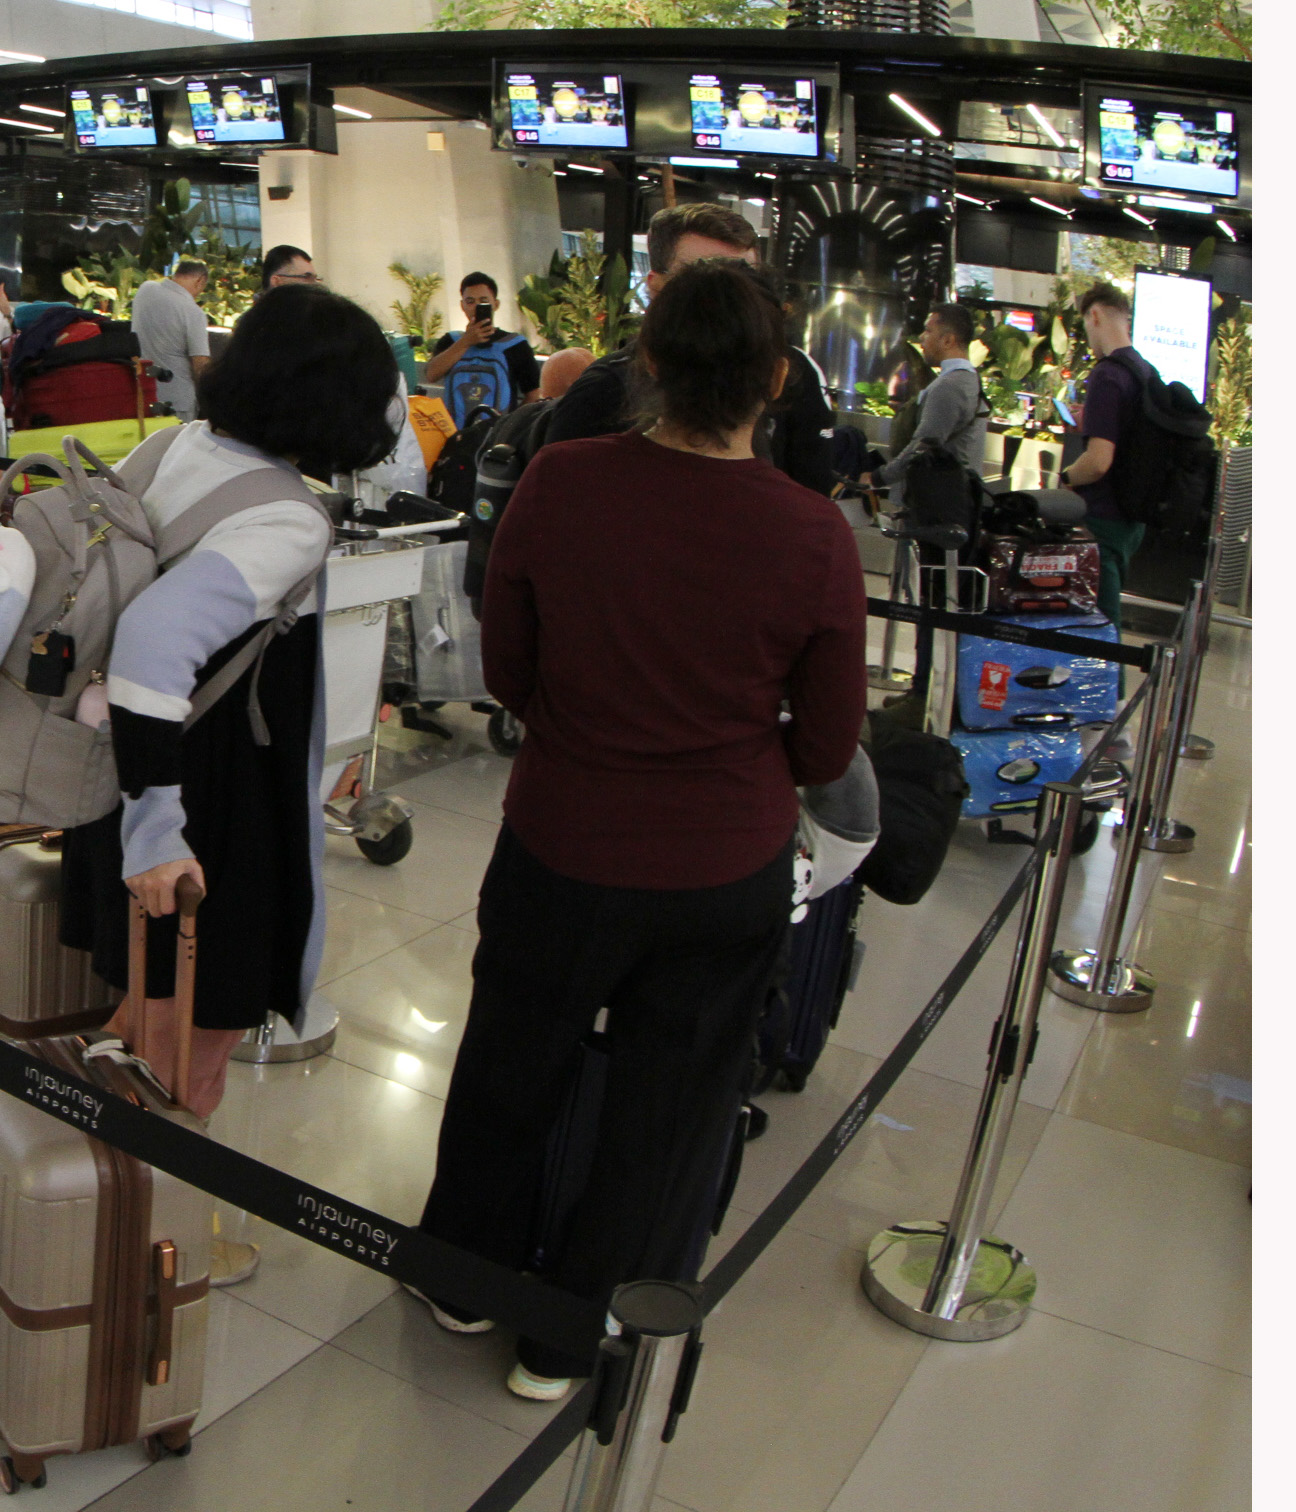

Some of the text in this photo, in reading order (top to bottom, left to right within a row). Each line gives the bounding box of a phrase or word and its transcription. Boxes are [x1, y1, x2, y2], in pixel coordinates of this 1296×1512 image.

[514, 88, 530, 97] C17
[1143, 335, 1198, 350] AVAILABLE
[1154, 324, 1185, 336] SPACE
[24, 1066, 104, 1118] injourney
[26, 1087, 98, 1129] AIRPORTS
[297, 1192, 399, 1254] injourney
[297, 1217, 389, 1266] AIRPORTS
